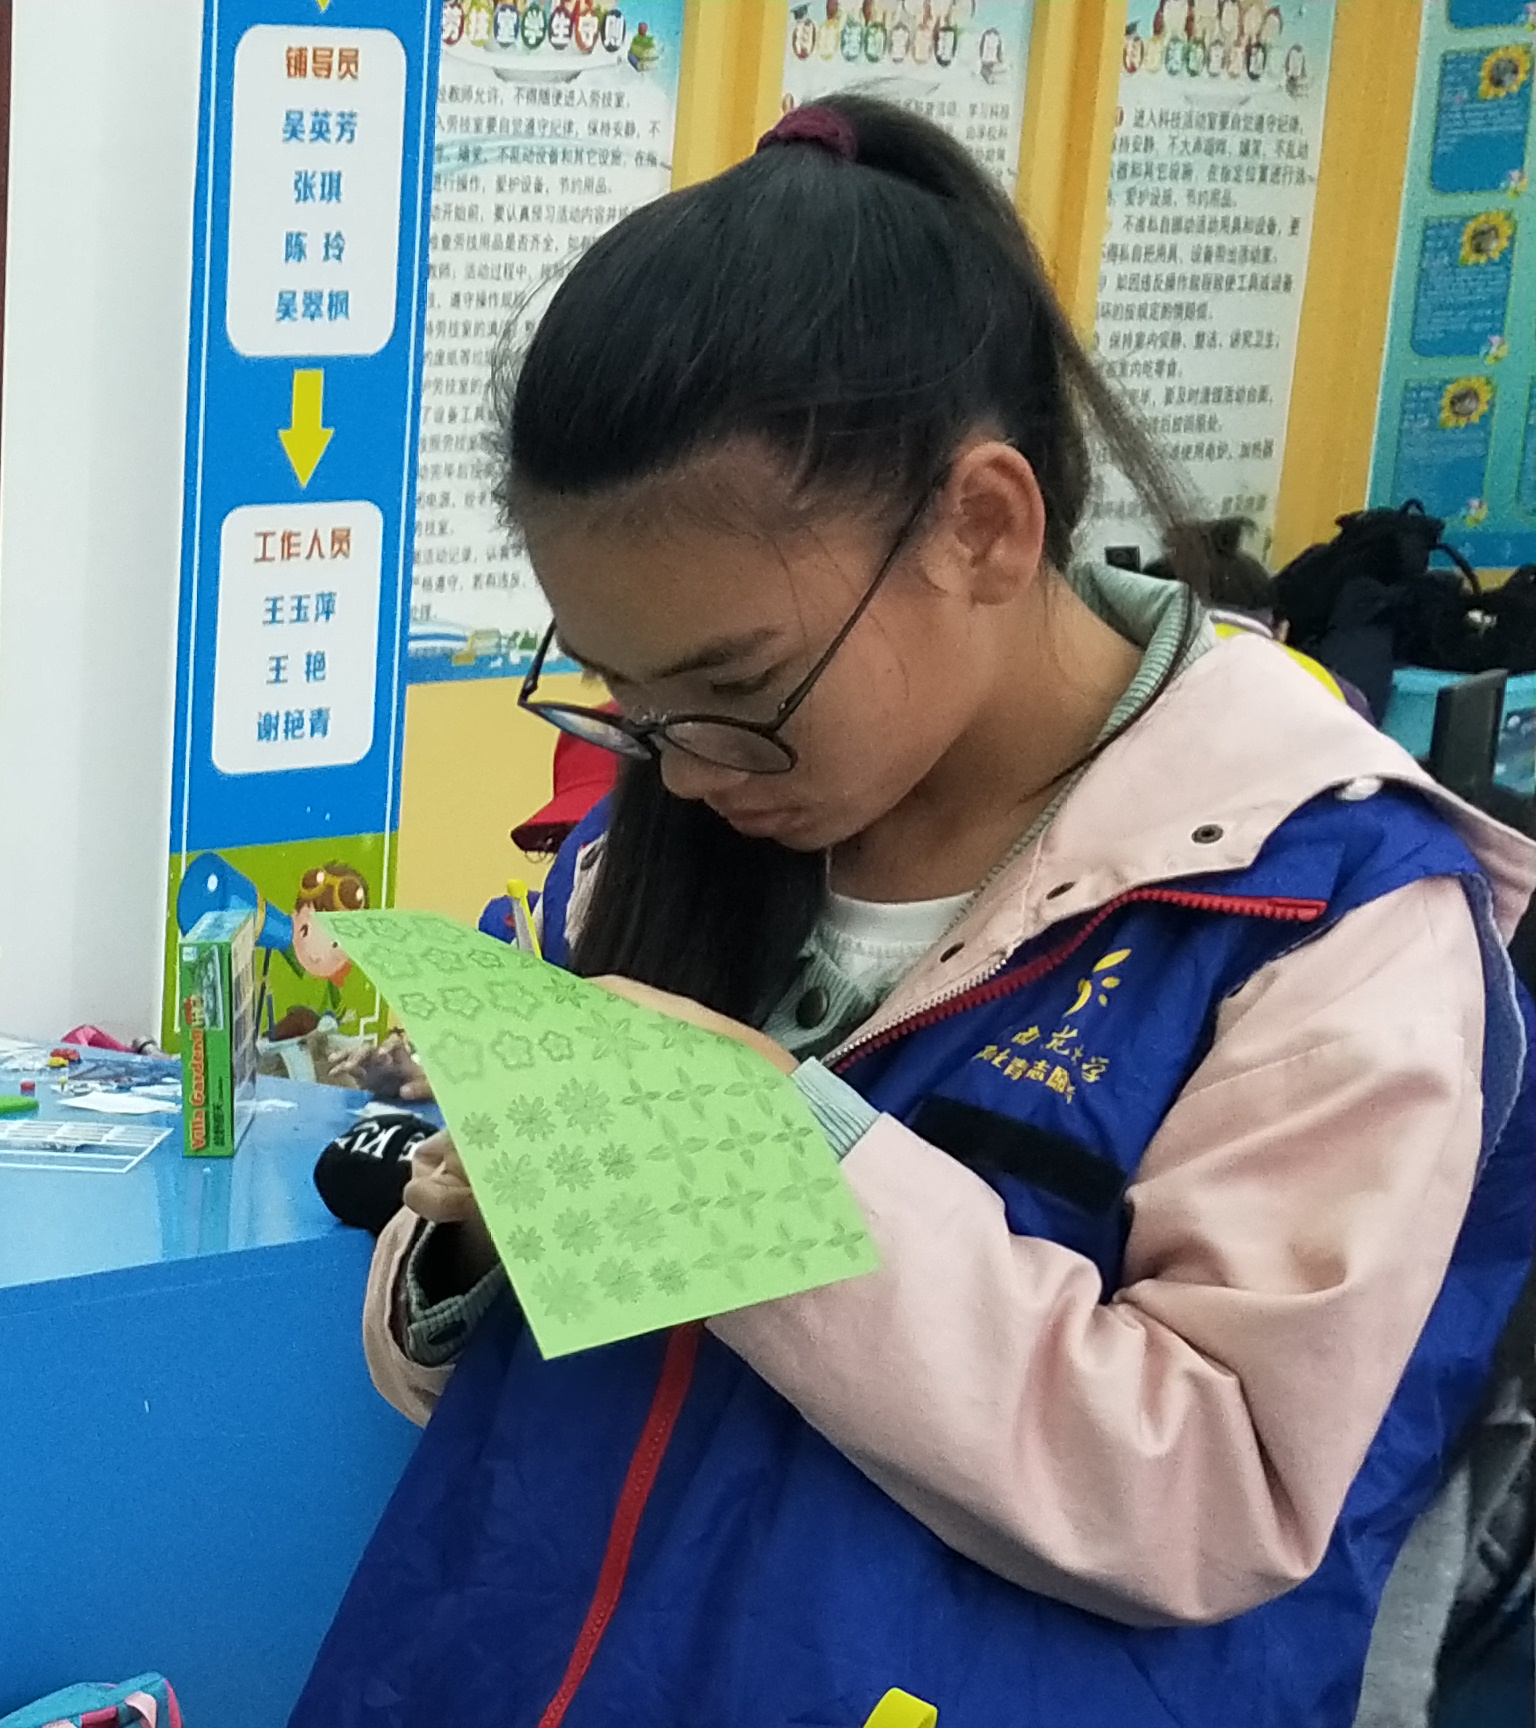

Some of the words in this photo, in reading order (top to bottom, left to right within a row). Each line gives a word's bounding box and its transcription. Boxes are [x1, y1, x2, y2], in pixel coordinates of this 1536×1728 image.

[285, 46, 359, 79] 辅导员
[282, 109, 358, 143] 吴英芳
[293, 170, 343, 203] 张琪
[254, 527, 351, 563] 工作人员
[263, 592, 336, 625] 王玉萍
